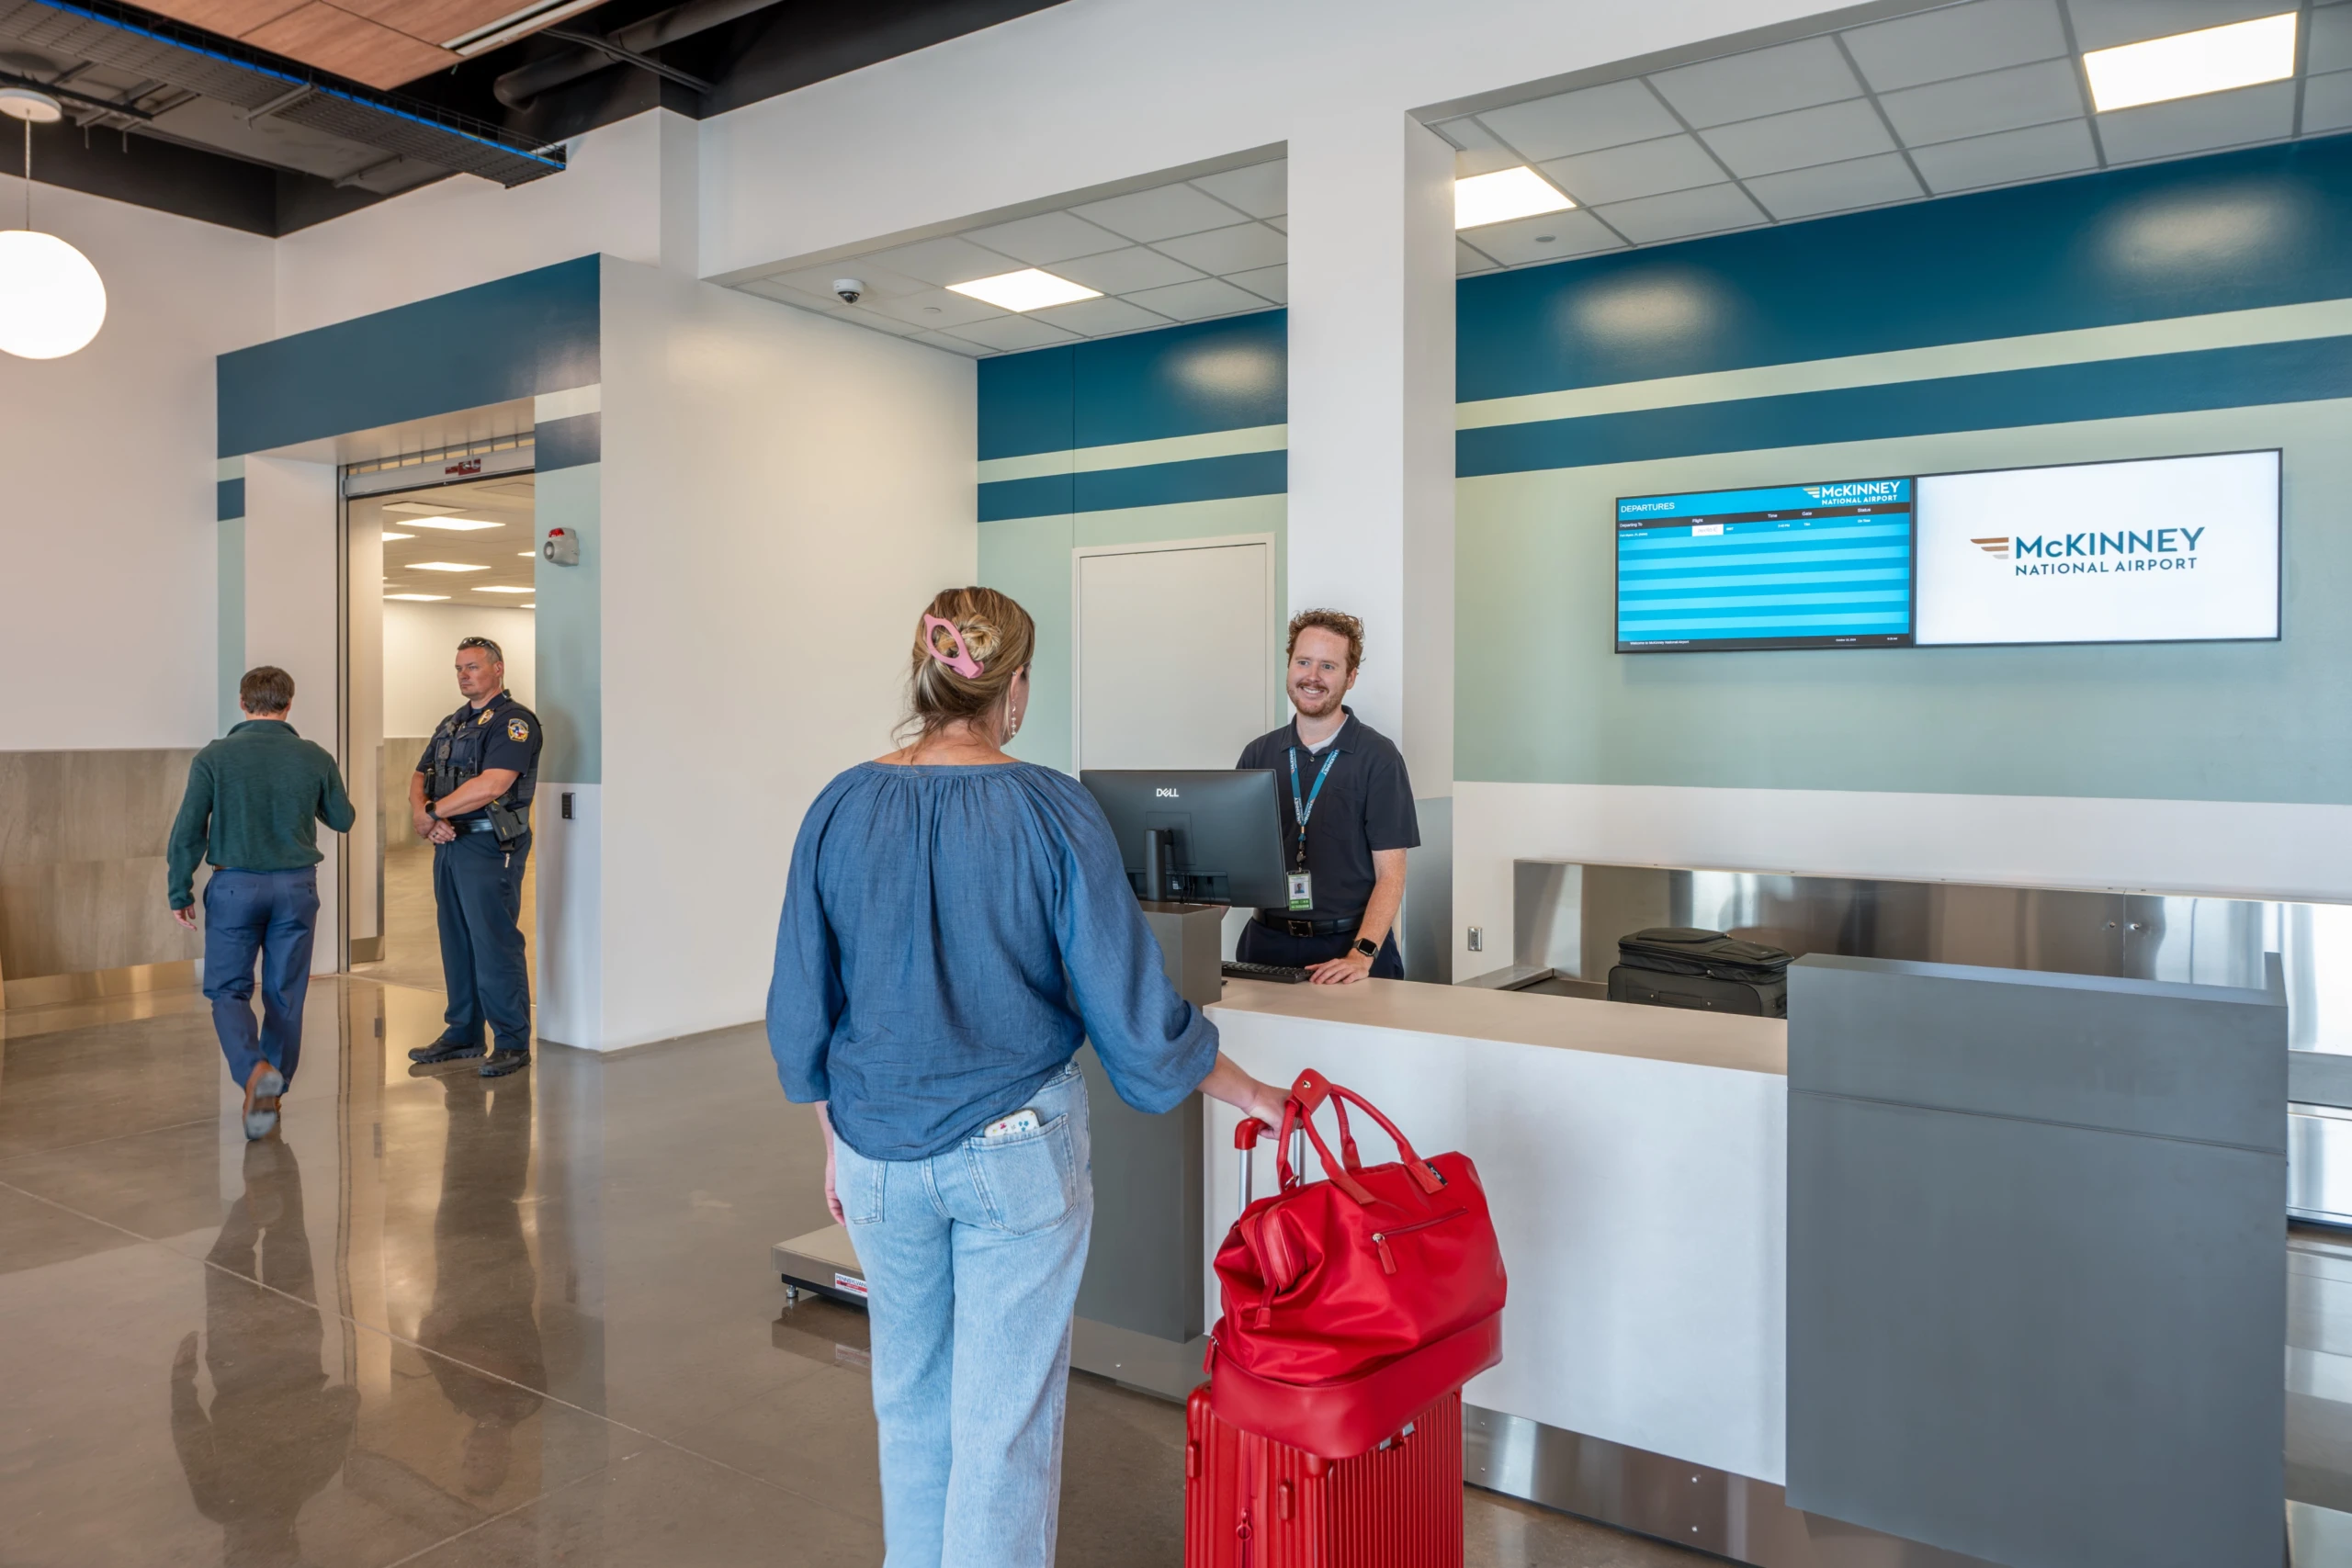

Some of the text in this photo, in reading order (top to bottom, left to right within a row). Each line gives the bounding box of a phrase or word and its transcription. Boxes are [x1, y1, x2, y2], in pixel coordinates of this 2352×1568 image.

[1822, 481, 1900, 498] McKINNEY
[1621, 502, 1675, 513] DEPARTURES
[2016, 526, 2205, 559] McKINNEY
[2016, 557, 2198, 576] NATIONAL AIRPORT
[1156, 788, 1179, 797] DELL
